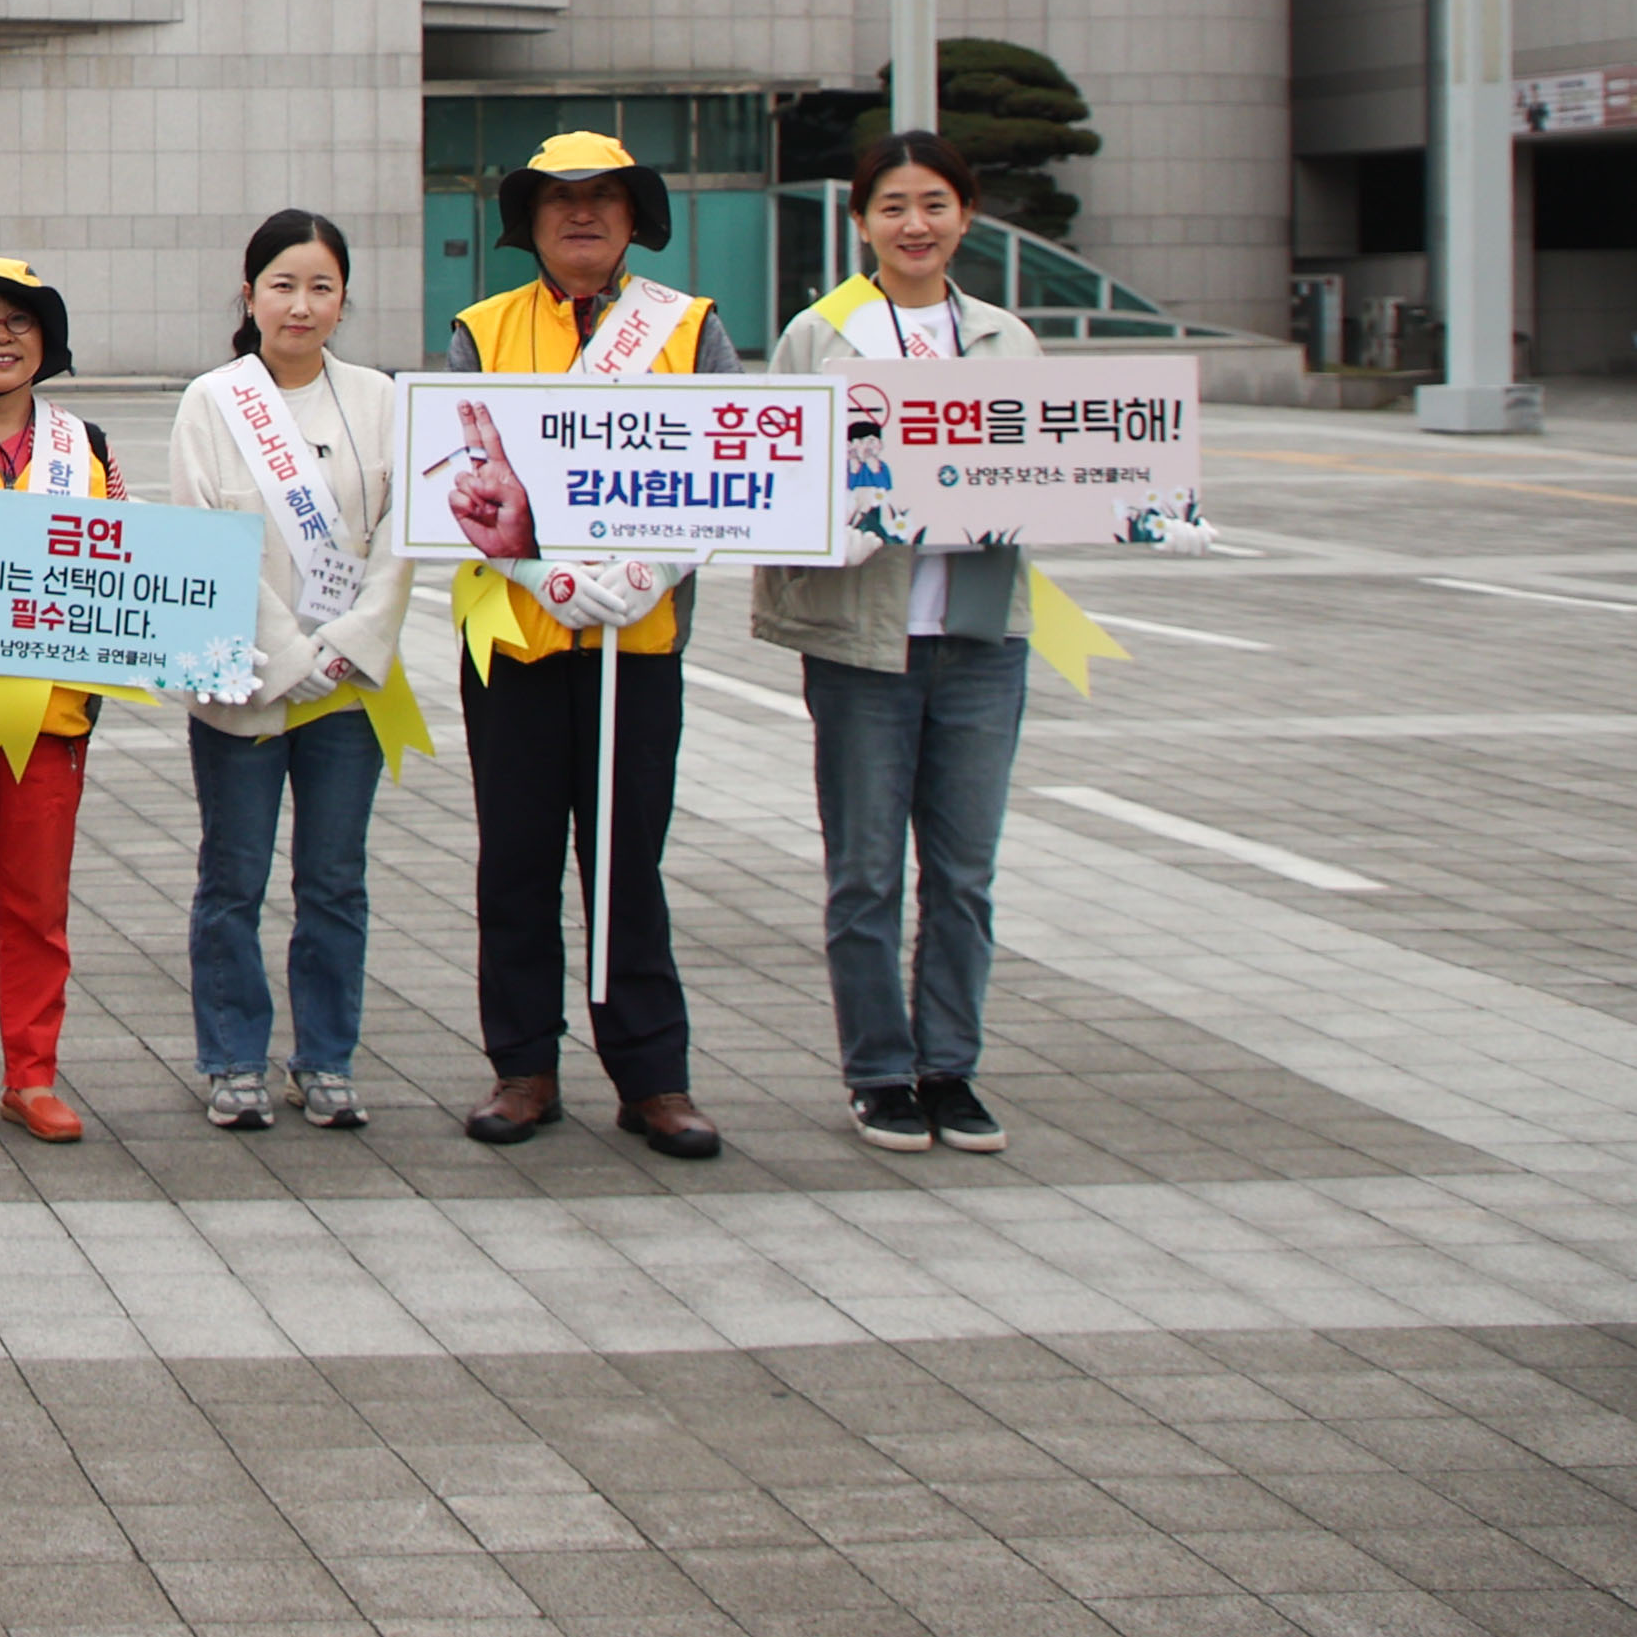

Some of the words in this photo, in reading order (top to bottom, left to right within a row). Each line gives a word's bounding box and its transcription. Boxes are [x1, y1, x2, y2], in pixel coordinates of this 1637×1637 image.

[232, 385, 300, 482] 노담노담
[541, 410, 692, 451] 매너있는
[703, 402, 804, 462] 흡연
[898, 399, 1027, 446] 금연을
[1038, 397, 1183, 445] 부탁해!
[566, 469, 775, 510] 감사합니다!
[965, 466, 1066, 486] 남양주보건소
[1072, 467, 1152, 485] 금연클리닉
[47, 513, 133, 563] 금연,
[611, 523, 686, 539] 남양주보건소
[689, 524, 752, 540] 금연클리닉
[42, 563, 124, 600] 선택이
[133, 571, 218, 609] 아니라
[9, 597, 157, 640] 필수입니다.
[0, 638, 91, 663] 남양주보건소
[96, 647, 167, 669] 금연클리닉
